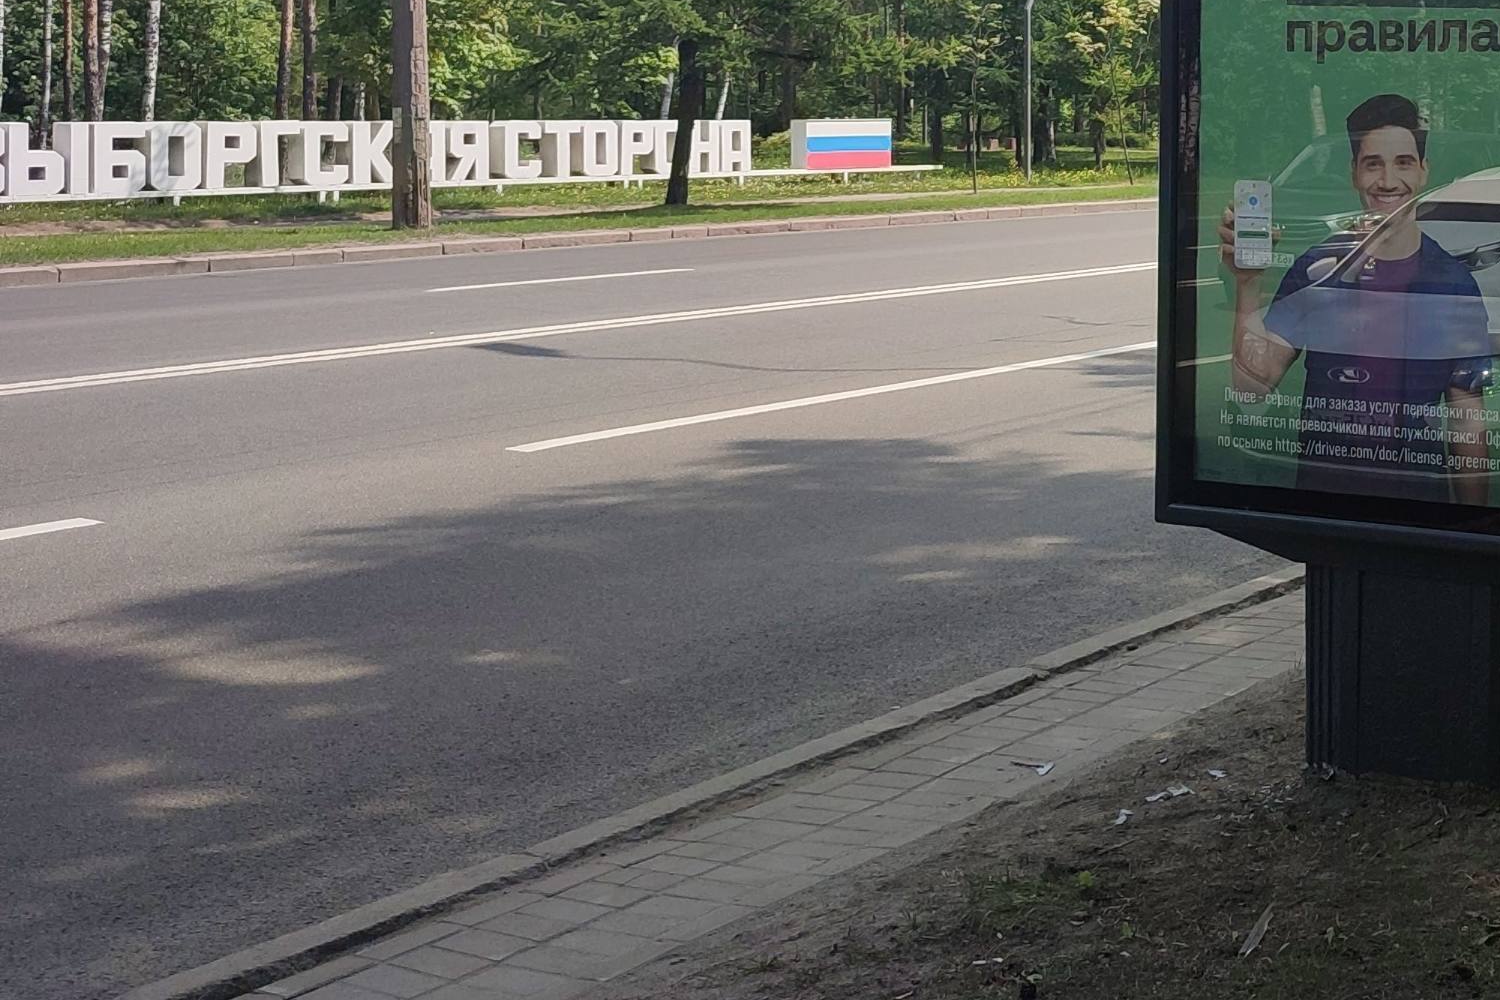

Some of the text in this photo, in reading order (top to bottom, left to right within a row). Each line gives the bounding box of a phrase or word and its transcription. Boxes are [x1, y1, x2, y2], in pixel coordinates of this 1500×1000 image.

[0, 120, 490, 196] ЫБОРГСКЯ
[1224, 386, 1256, 404] Drivee
[1265, 392, 1303, 408] сервис
[1305, 396, 1326, 409] для
[1328, 398, 1367, 412] заказа
[1369, 401, 1400, 417] услуг
[1403, 403, 1463, 419] перевозки
[1220, 408, 1234, 425] Не
[1236, 413, 1286, 429] является
[1289, 418, 1368, 436] перевозчиком
[1369, 425, 1391, 438] или
[1394, 425, 1444, 442] службой
[1217, 435, 1231, 447] по
[1232, 437, 1273, 451] ссылке
